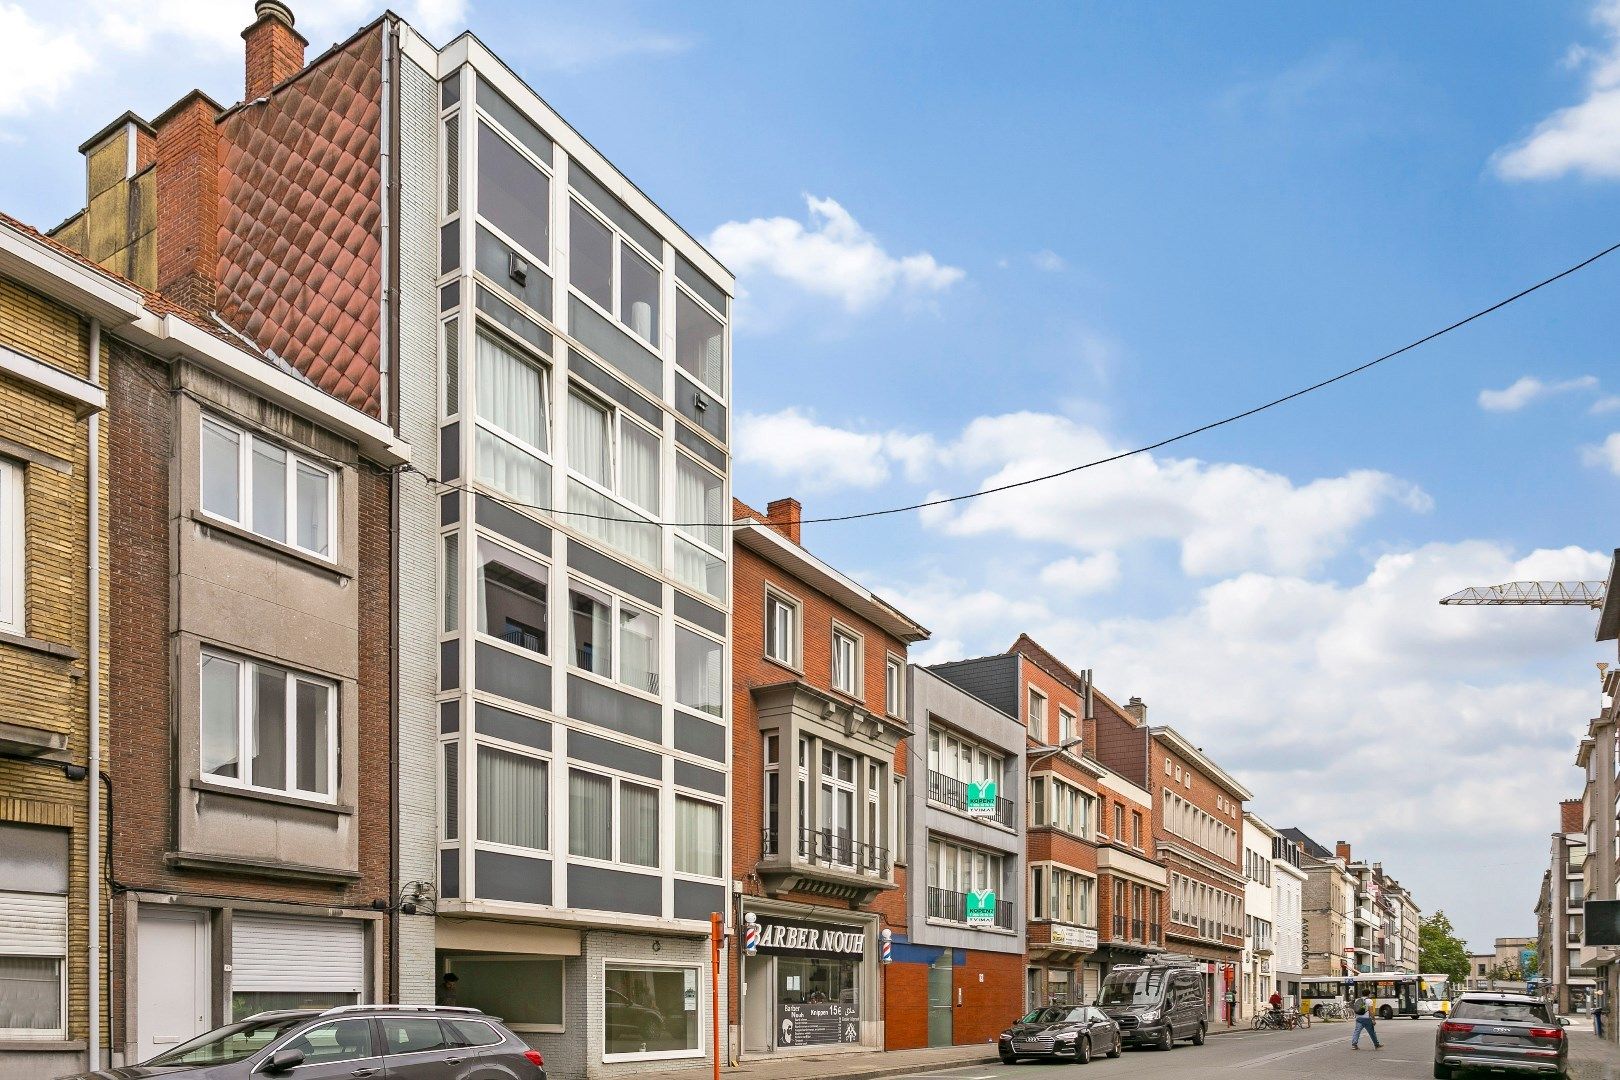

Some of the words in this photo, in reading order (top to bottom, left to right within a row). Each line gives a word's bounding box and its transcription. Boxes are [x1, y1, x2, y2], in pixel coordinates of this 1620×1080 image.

[820, 930, 865, 954] NOUH
[784, 1004, 801, 1012] Barber
[810, 1009, 829, 1017] Knippen
